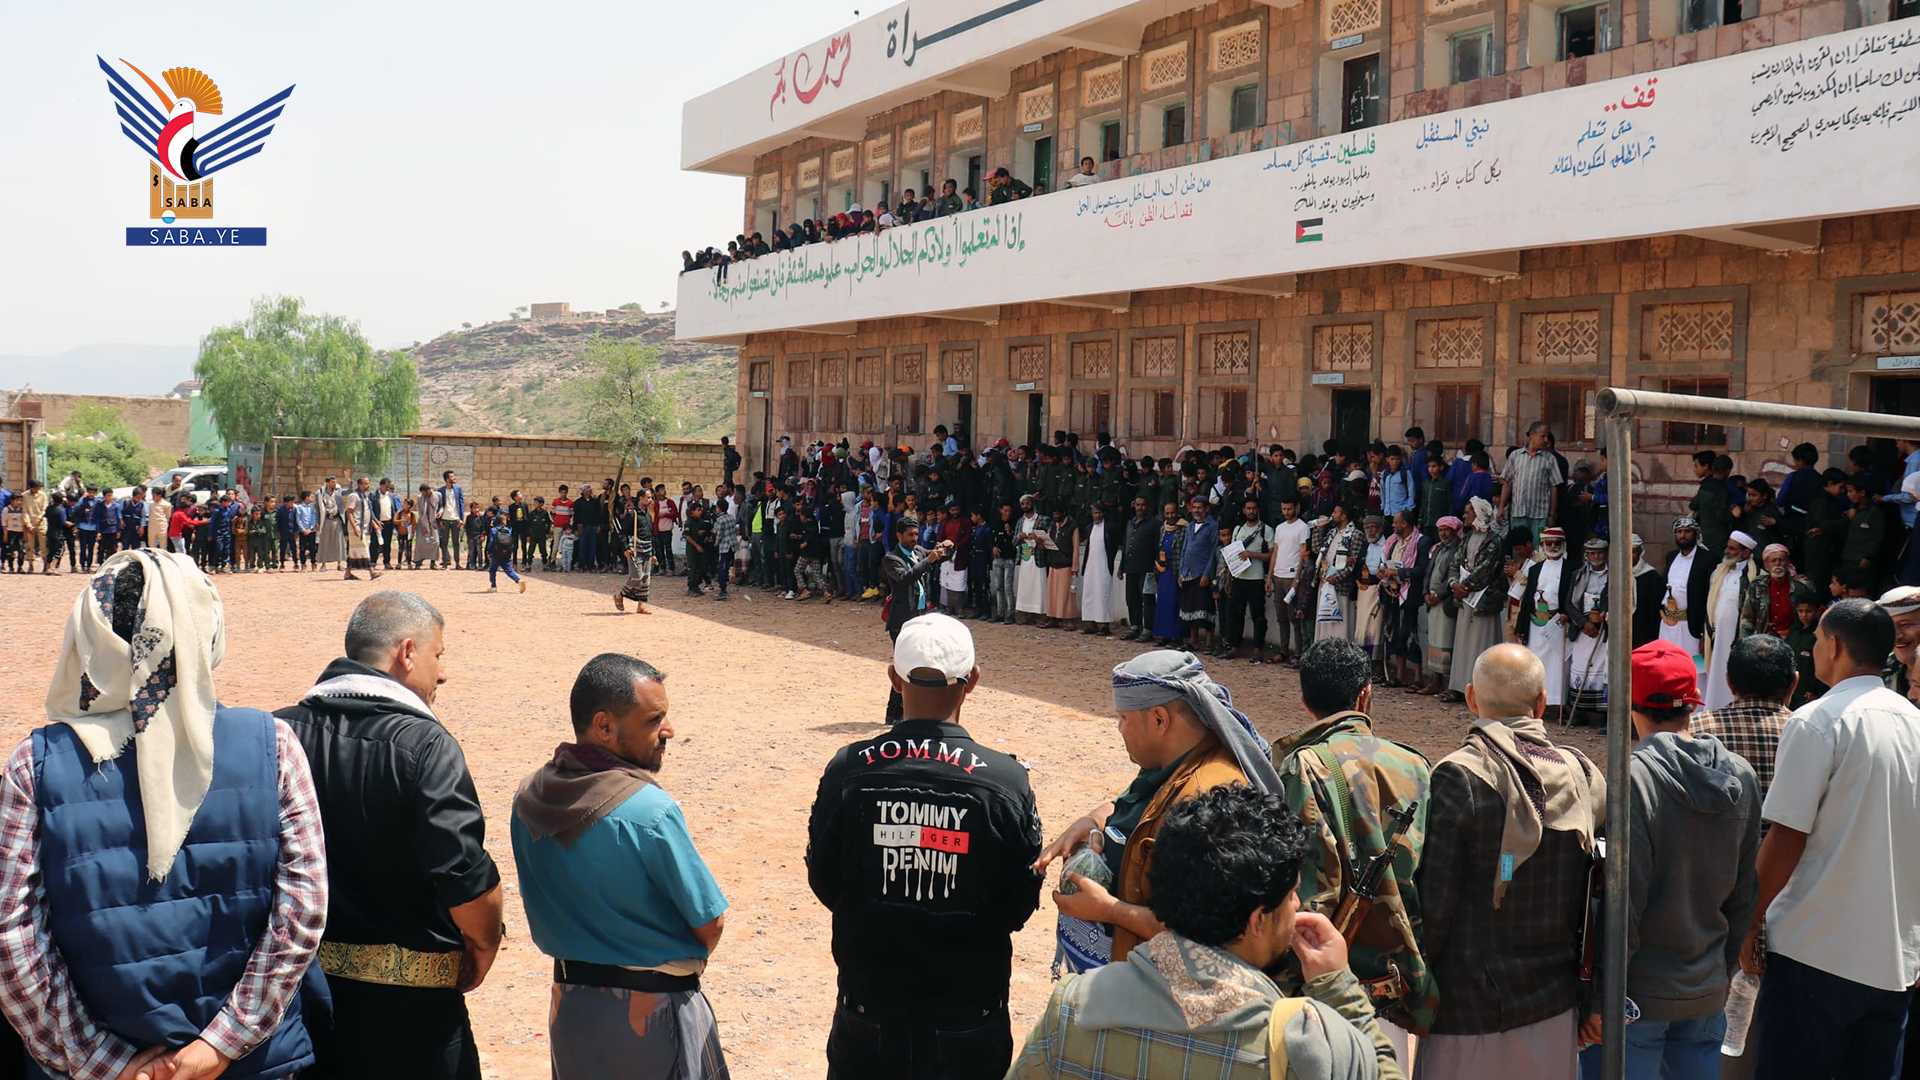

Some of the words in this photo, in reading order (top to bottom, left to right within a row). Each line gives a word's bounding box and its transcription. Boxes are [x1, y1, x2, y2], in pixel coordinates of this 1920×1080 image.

[1416, 117, 1462, 149] المستقبل
[1455, 158, 1483, 190] كتاب
[858, 738, 988, 775] TOMMY
[876, 800, 968, 831] TOMMY
[880, 829, 961, 847] HILFIGER
[882, 847, 958, 884] DENIM
